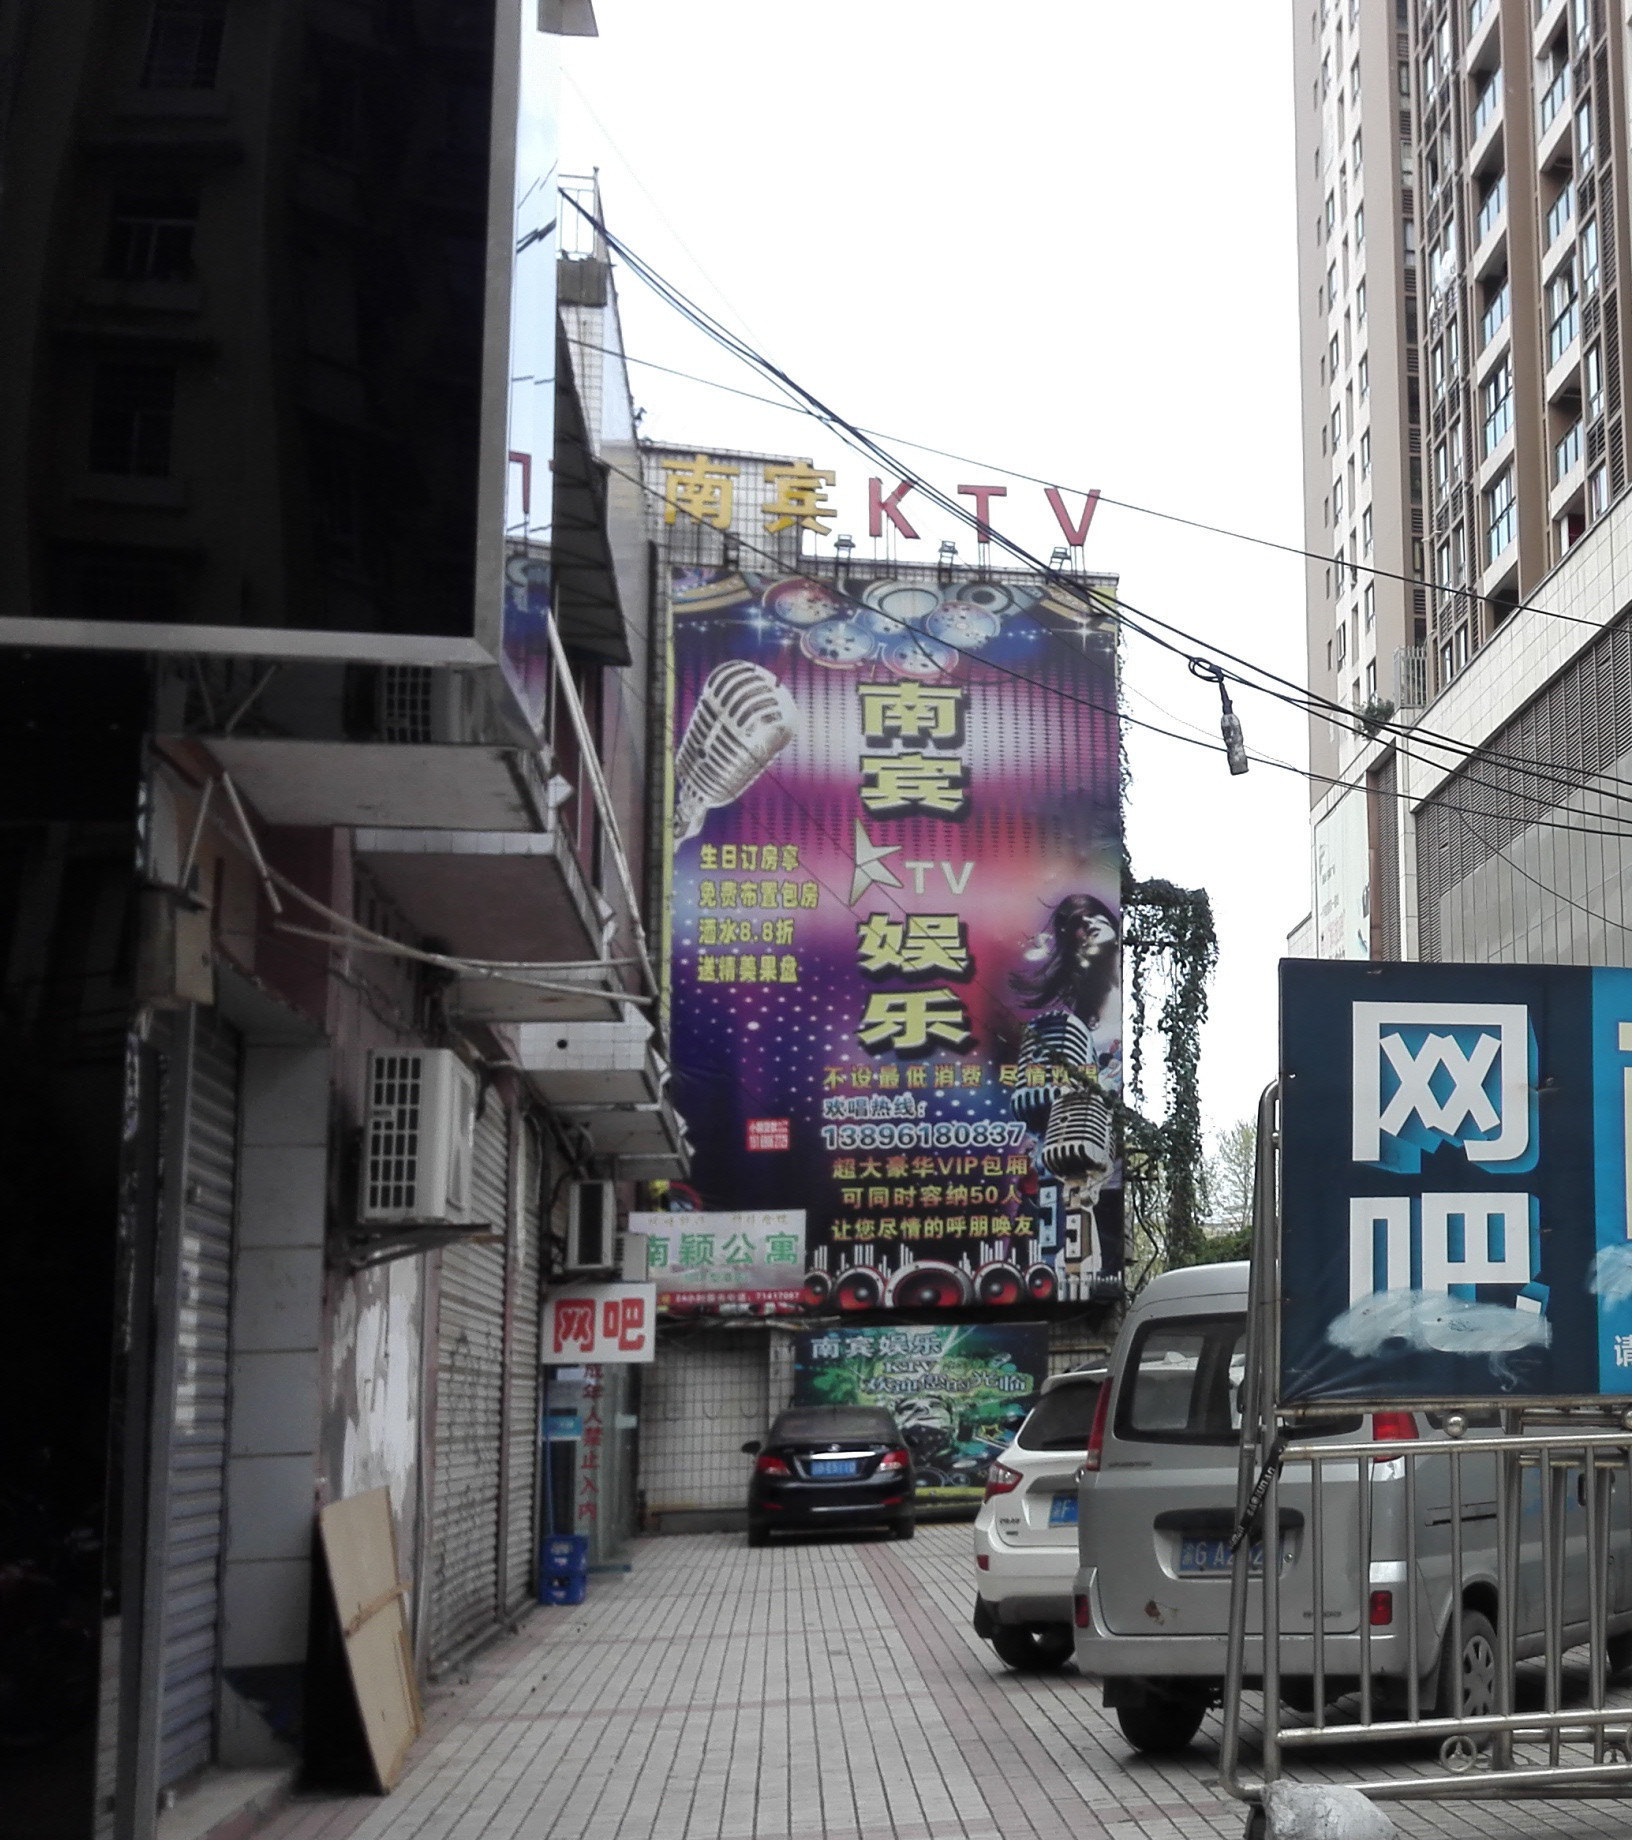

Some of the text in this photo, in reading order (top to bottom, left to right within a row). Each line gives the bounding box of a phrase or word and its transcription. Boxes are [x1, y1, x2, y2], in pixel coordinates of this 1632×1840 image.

[699, 843, 799, 872] 生日订房享
[699, 880, 820, 909] 免费布置包房
[698, 916, 795, 946] 酒水8.8折
[822, 1064, 983, 1089] 不设最低消费
[820, 1120, 1028, 1150] 13896180837
[832, 1154, 1030, 1180] 超大豪华VIP包厢
[1348, 1000, 1550, 1352] 网吧
[841, 1184, 1024, 1208] 可同时容纳50人
[831, 1216, 1035, 1242] 让您尽情的呼朋唤友
[553, 1296, 646, 1354] 网吧
[811, 1333, 943, 1359] 南宾娱乐
